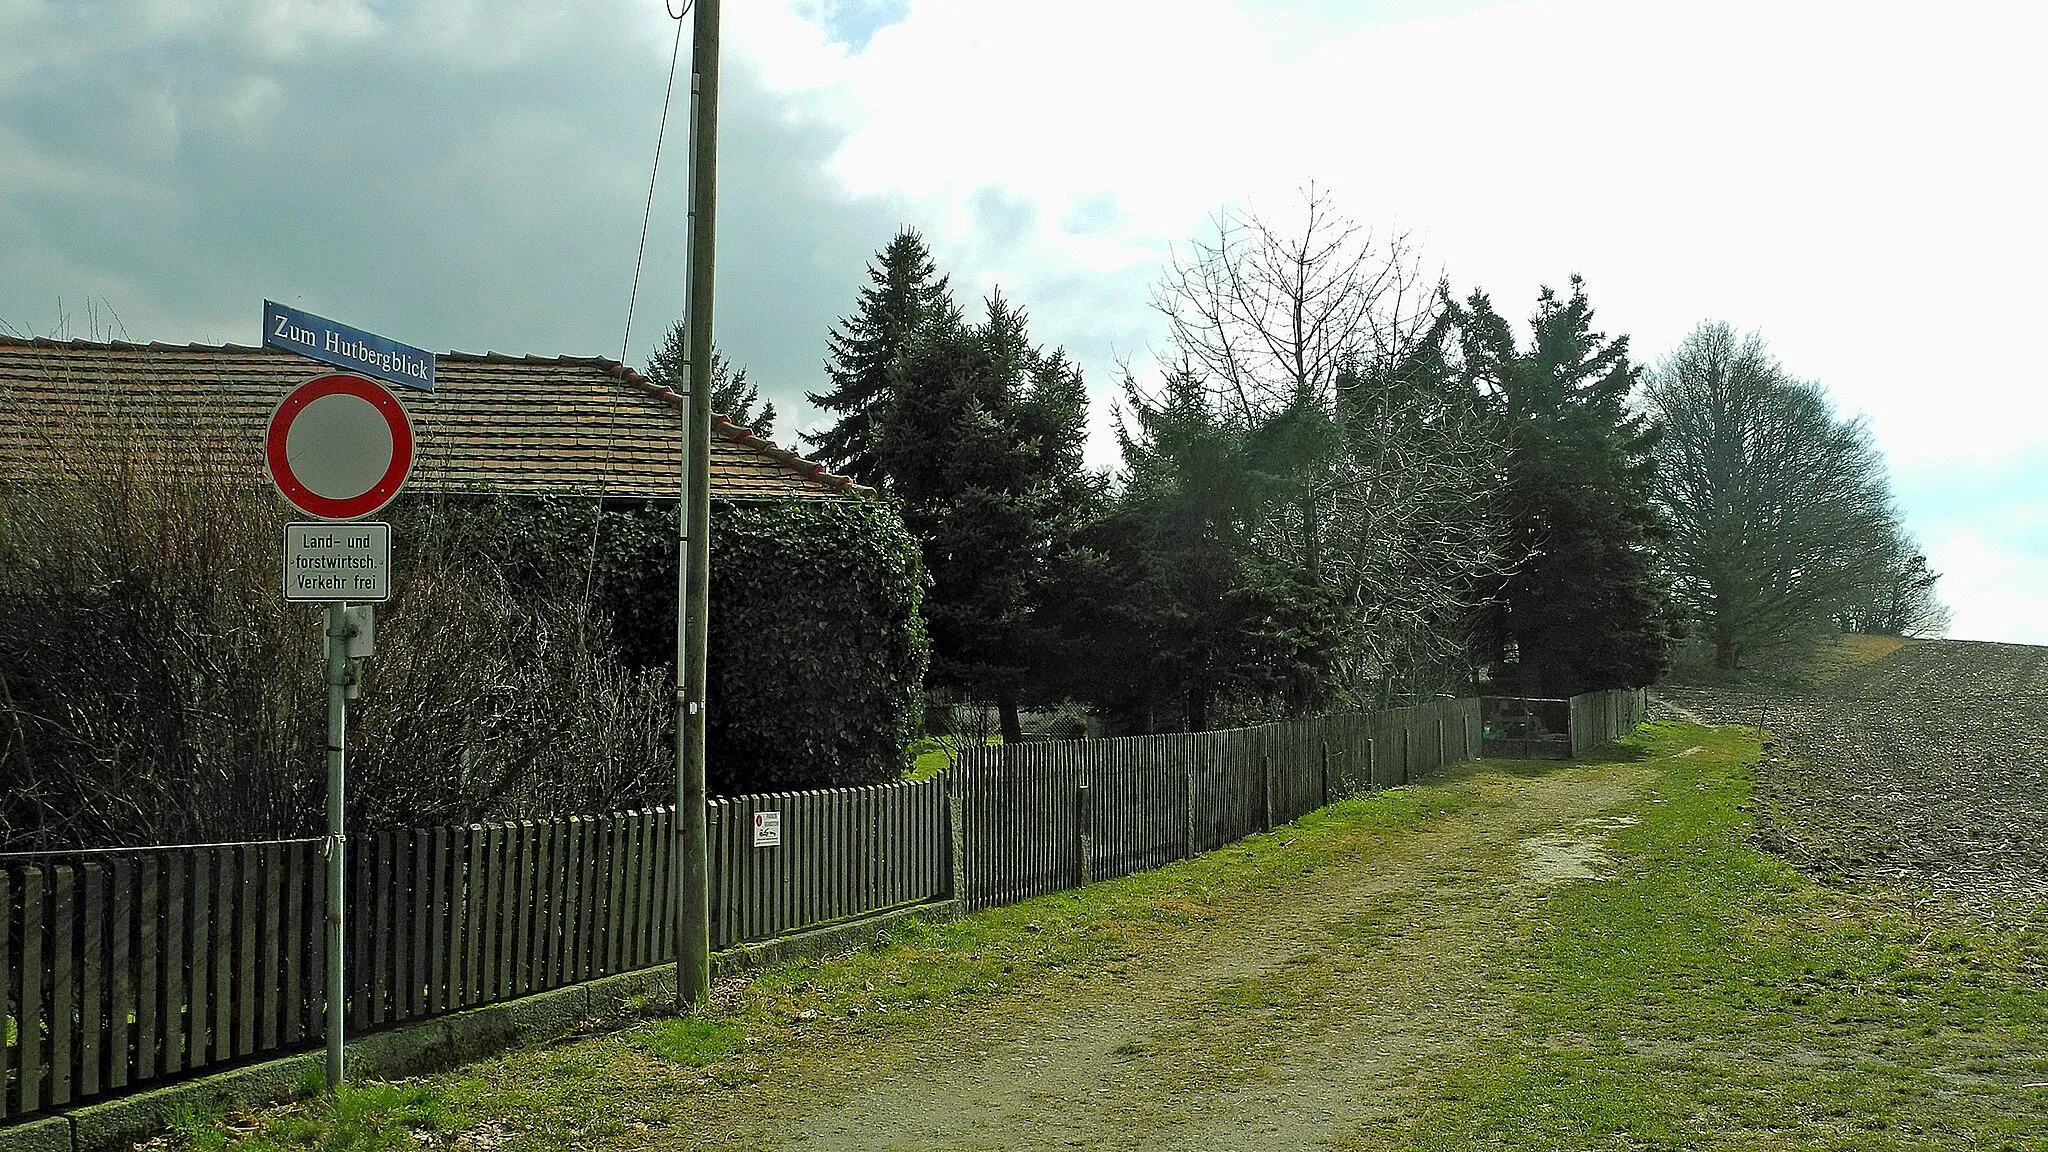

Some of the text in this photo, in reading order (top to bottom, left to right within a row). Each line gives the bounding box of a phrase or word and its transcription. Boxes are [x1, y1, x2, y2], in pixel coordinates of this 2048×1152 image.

[274, 314, 429, 381] Zum Hutbergblick
[303, 533, 371, 549] Land- und
[296, 554, 378, 569] forstwirtsch.
[297, 574, 376, 589] Verkehr frei
